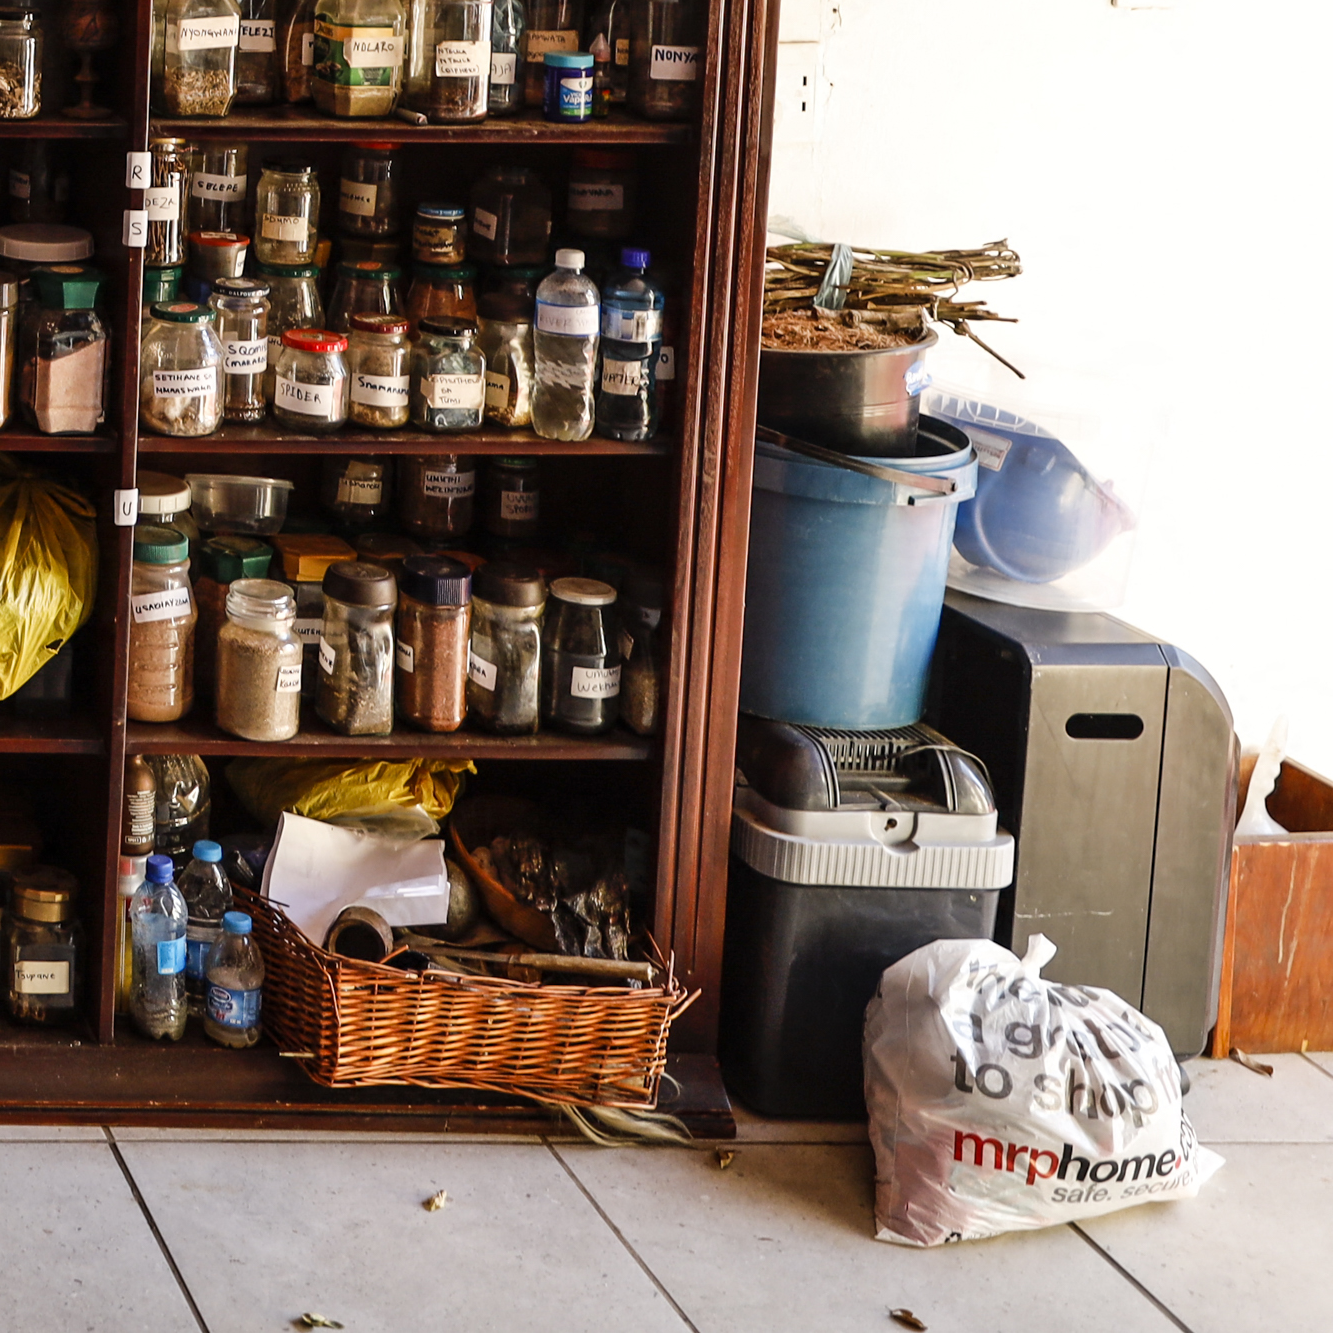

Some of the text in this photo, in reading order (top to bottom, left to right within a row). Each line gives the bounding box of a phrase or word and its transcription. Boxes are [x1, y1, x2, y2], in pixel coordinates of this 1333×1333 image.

[132, 165, 143, 181] R
[131, 221, 143, 236] S
[280, 383, 322, 403] SPIDER
[122, 501, 133, 517] U
[950, 1053, 1014, 1100] to
[1050, 1181, 1113, 1204] safe.
